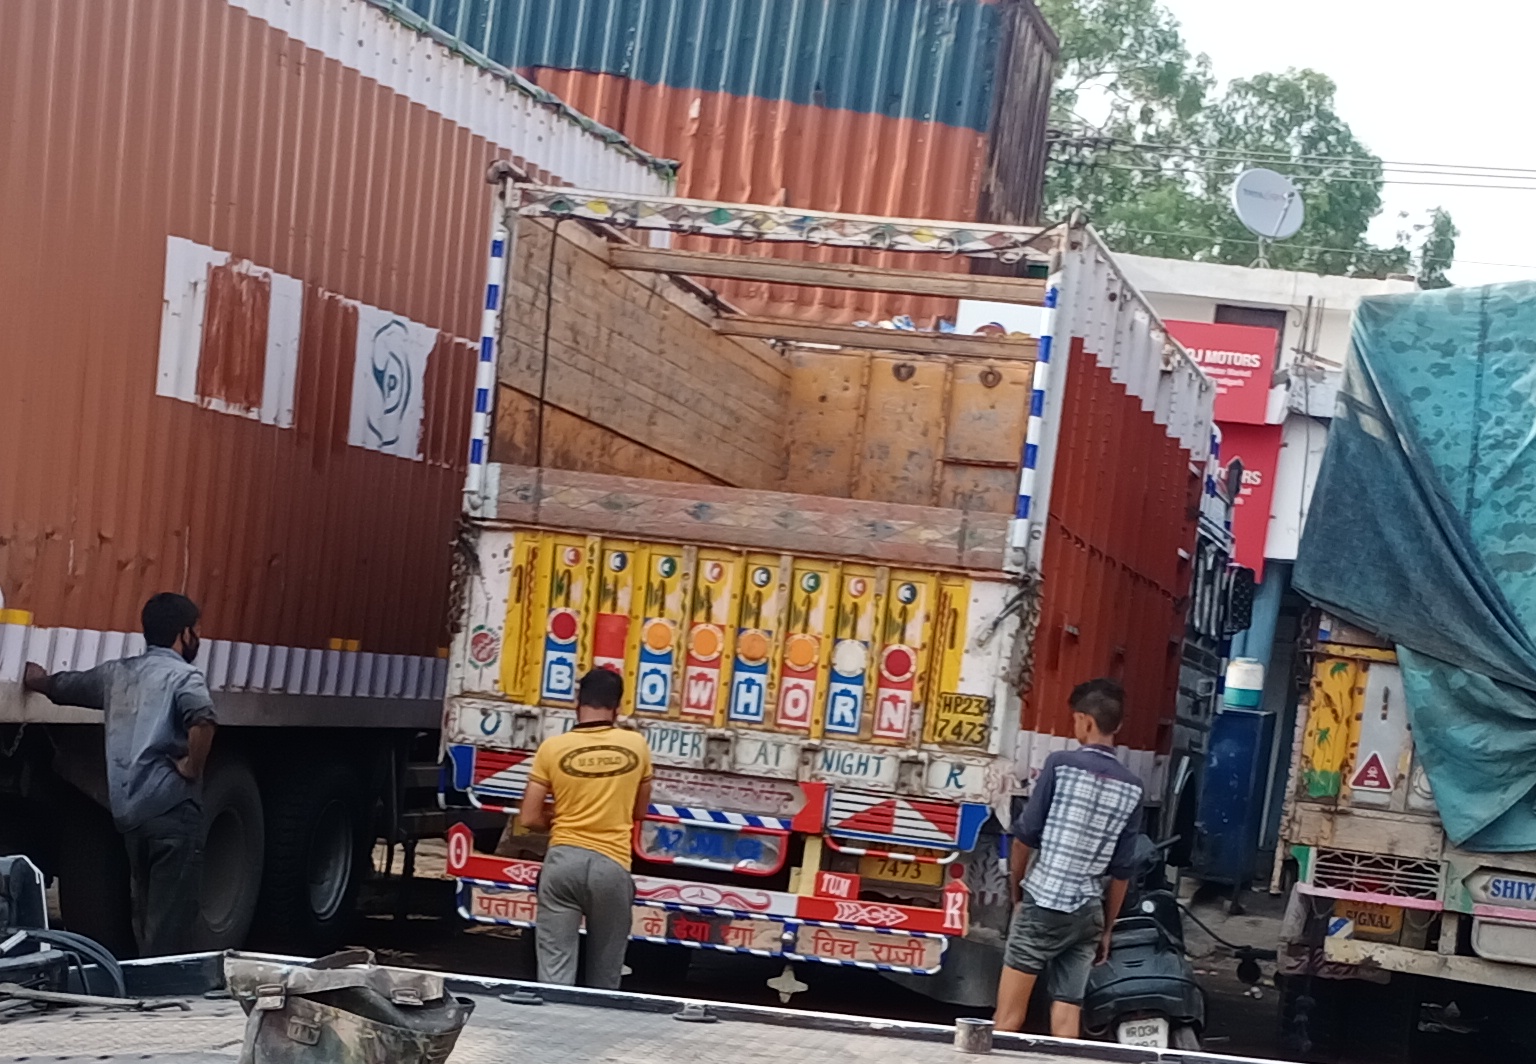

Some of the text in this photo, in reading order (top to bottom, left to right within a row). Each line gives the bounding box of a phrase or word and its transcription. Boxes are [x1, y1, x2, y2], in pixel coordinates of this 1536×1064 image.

[1204, 349, 1261, 368] MOTORS
[935, 718, 989, 745] 7473
[754, 742, 783, 767] AT
[820, 751, 887, 777] NIGHT
[876, 858, 922, 880] 7473
[813, 927, 858, 960] विच
